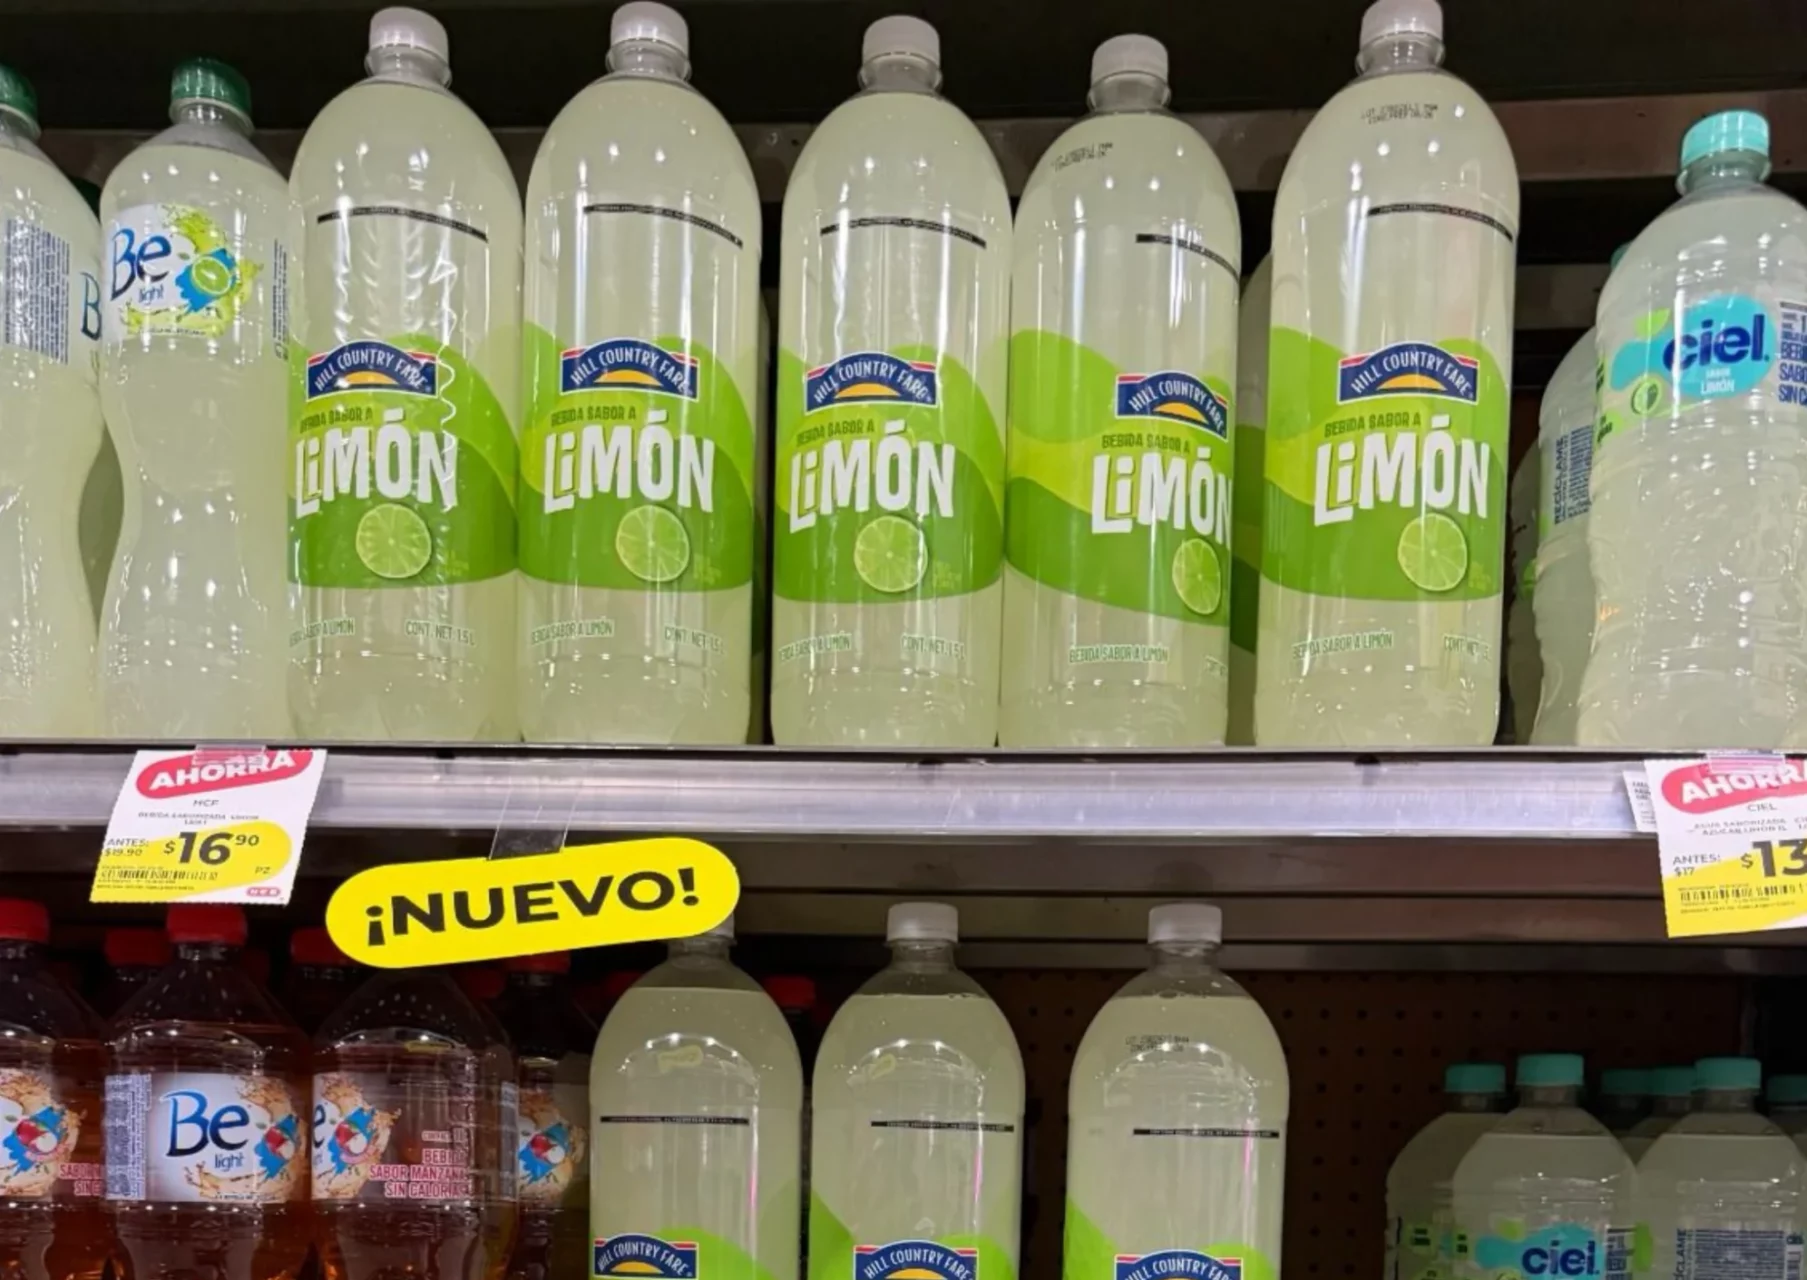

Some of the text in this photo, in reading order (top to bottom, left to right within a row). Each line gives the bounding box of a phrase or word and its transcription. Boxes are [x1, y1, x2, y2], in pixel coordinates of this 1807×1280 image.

[111, 228, 172, 300] Be
[138, 285, 164, 305] light
[314, 363, 337, 391] HILL
[337, 349, 395, 369] COUNTRY
[571, 357, 599, 386] HILL
[599, 347, 658, 369] COUNTRY
[1351, 351, 1472, 396] HILL COUNTRY FARE
[814, 375, 838, 403] HILL
[838, 360, 898, 382] COUNTRY
[1128, 385, 1159, 412] HILL
[1158, 380, 1208, 406] COUNTRY
[587, 406, 624, 421] SABOR
[628, 406, 637, 420] A
[1324, 411, 1421, 438] BEBIDA SABOR A
[827, 419, 875, 437] SABOR A
[1102, 433, 1143, 450] BEBIDA
[1146, 434, 1182, 452] SABOR
[149, 752, 295, 790] AHORRA
[1682, 760, 1807, 804] AHORR
[1747, 802, 1777, 812] CIEL
[107, 838, 150, 848] ANTES:
[1672, 854, 1721, 865] ANTES:
[1674, 866, 1695, 877] $17
[365, 867, 700, 946] ¡NUEVO!
[160, 1089, 250, 1158] Be
[214, 1153, 244, 1171] light
[370, 1165, 409, 1181] SABOR
[384, 1182, 407, 1198] SIN
[613, 1241, 660, 1259] COUNTRY
[660, 1251, 688, 1276] FARE
[863, 1255, 889, 1279] HILL
[889, 1248, 944, 1269] COUNTRY
[1152, 1257, 1207, 1277] COUNTRY
